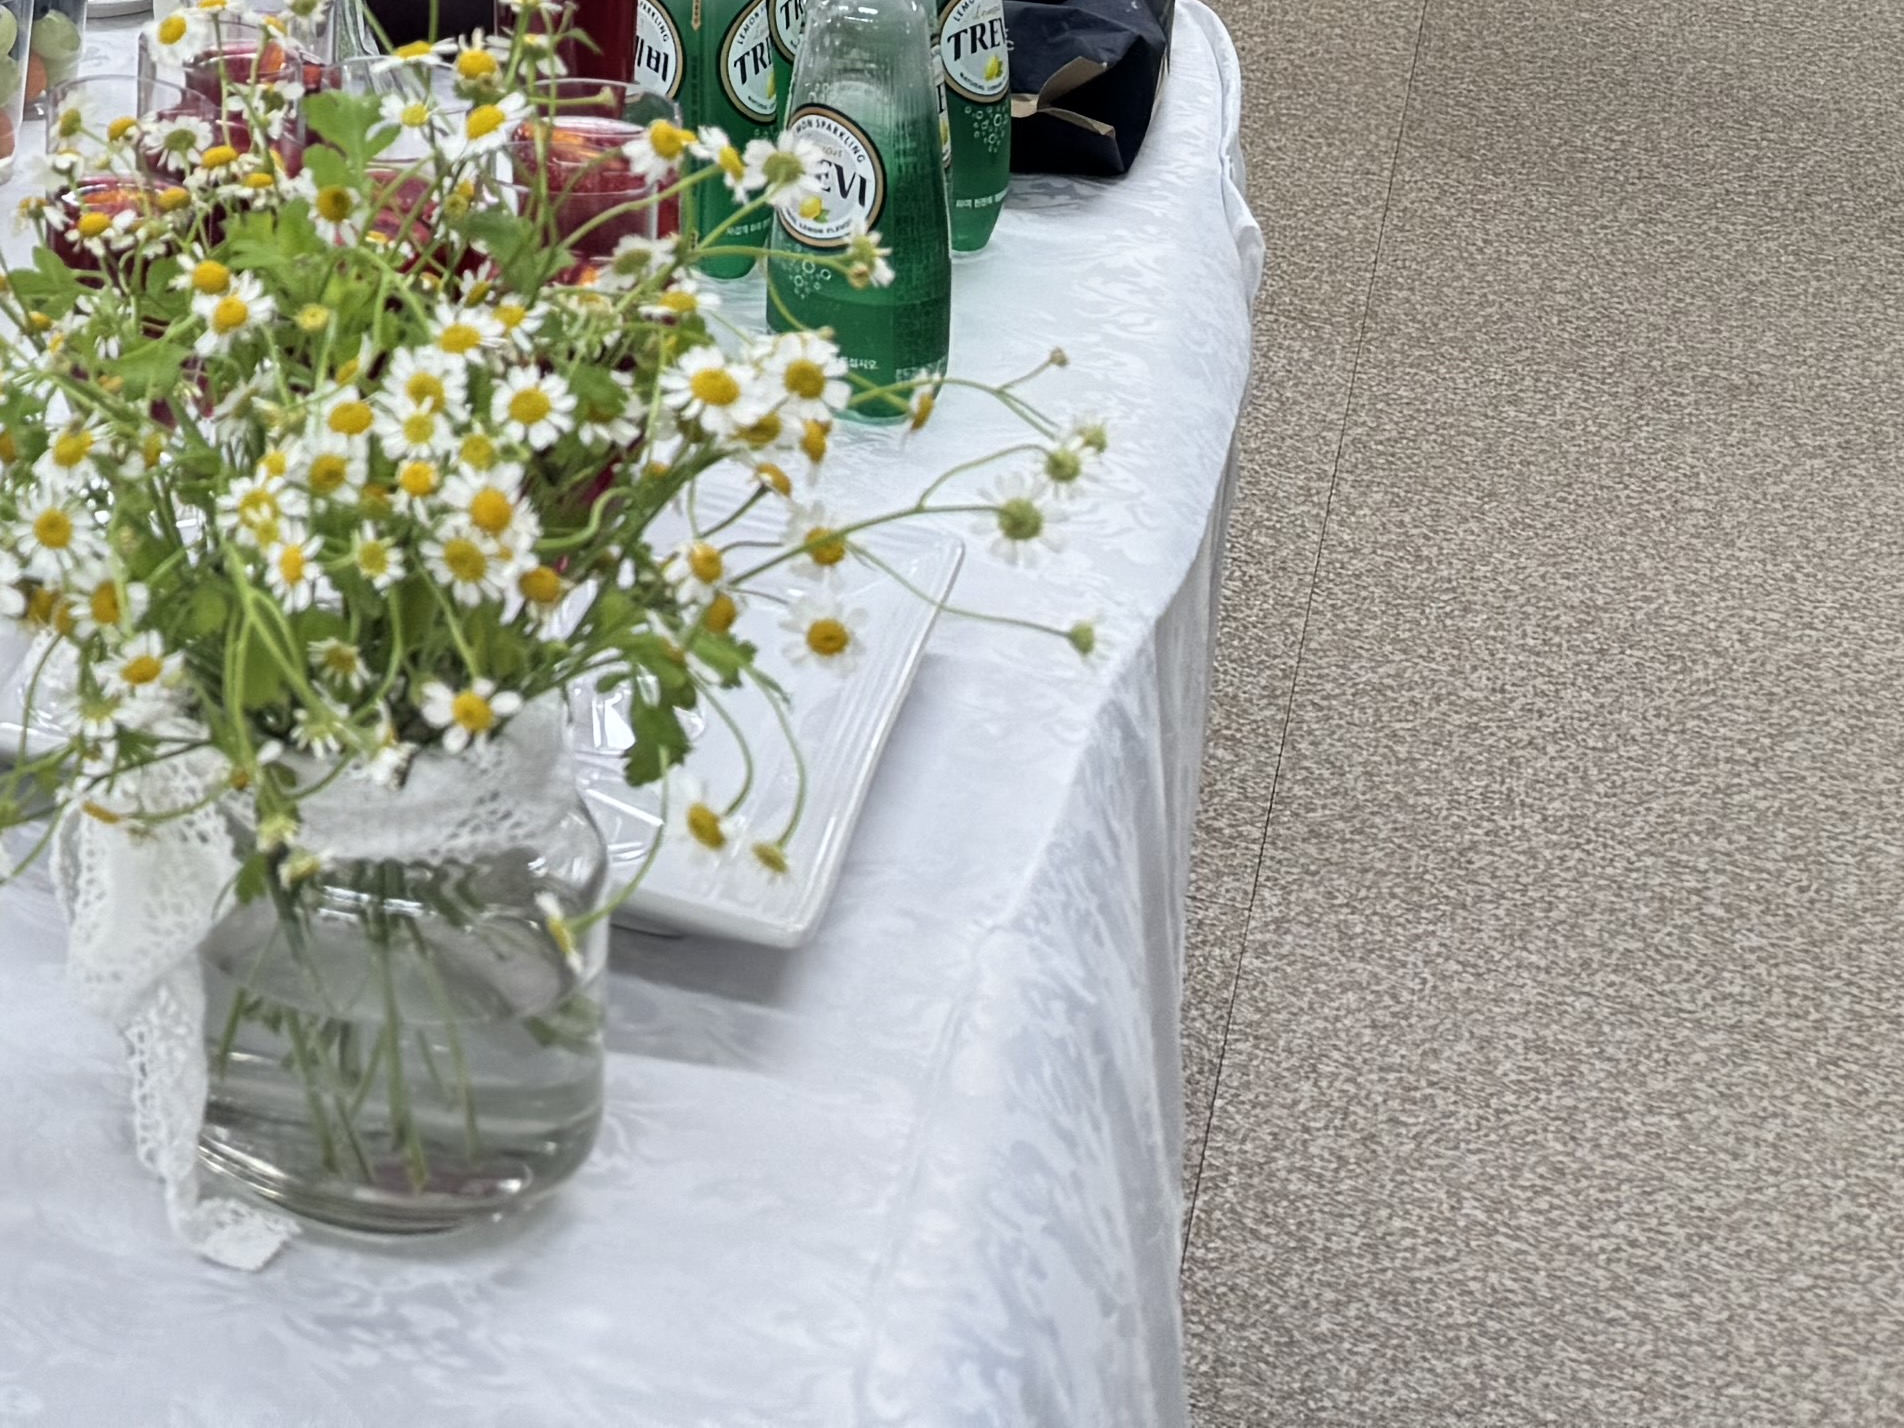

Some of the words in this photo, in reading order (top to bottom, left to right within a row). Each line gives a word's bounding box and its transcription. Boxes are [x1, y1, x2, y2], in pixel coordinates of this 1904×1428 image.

[639, 1, 670, 43] PARKLING
[947, 18, 1006, 63] TREV
[816, 118, 866, 164] SPARKLING
